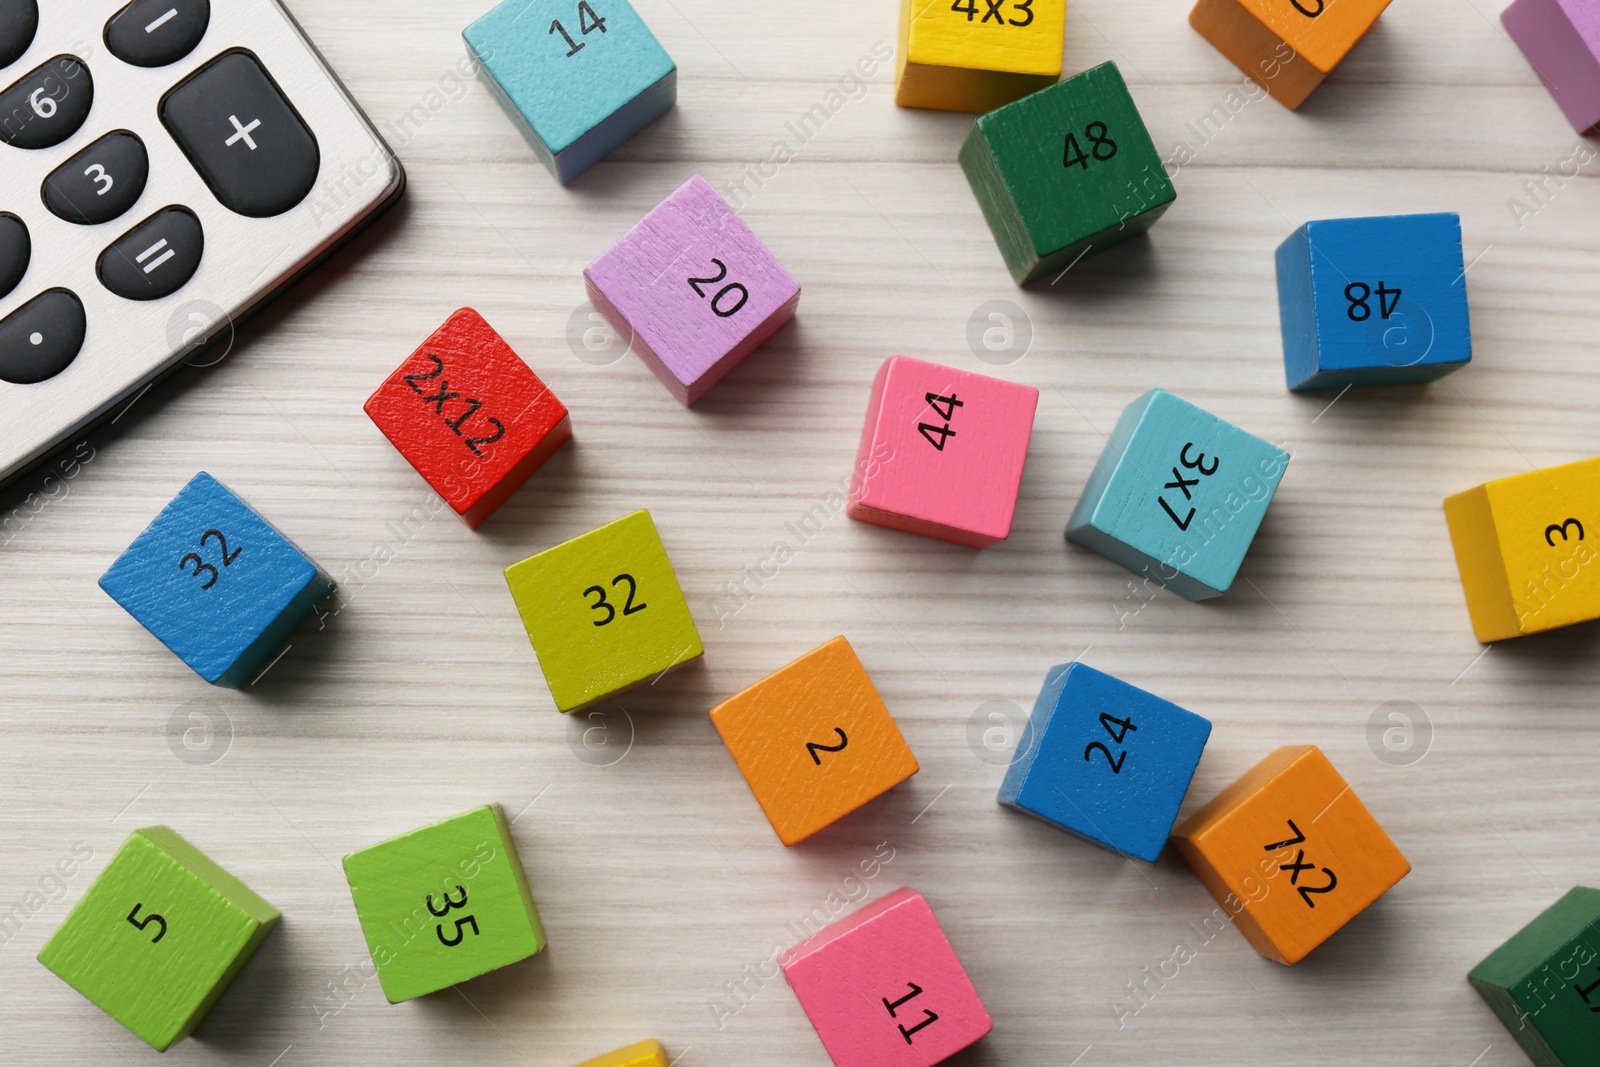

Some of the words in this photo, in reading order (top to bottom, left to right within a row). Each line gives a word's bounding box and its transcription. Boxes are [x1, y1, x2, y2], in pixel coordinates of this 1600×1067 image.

[548, 1, 607, 58] 14
[951, 0, 1034, 27] 4x3
[28, 86, 58, 119] 6
[1062, 120, 1119, 171] 48
[83, 163, 114, 196] 3
[687, 258, 749, 318] 20
[1344, 280, 1402, 322] 48
[404, 354, 505, 457] 2x12
[917, 392, 963, 451] 44
[1157, 442, 1219, 531] 3x7
[179, 529, 243, 589] 32
[1545, 518, 1584, 547] 3
[583, 573, 647, 627] 32
[806, 727, 848, 765] 2
[1084, 712, 1137, 774] 24
[1264, 819, 1337, 908] 7x2
[127, 903, 167, 944] 5
[426, 885, 480, 947] 35
[882, 982, 939, 1045] 11
